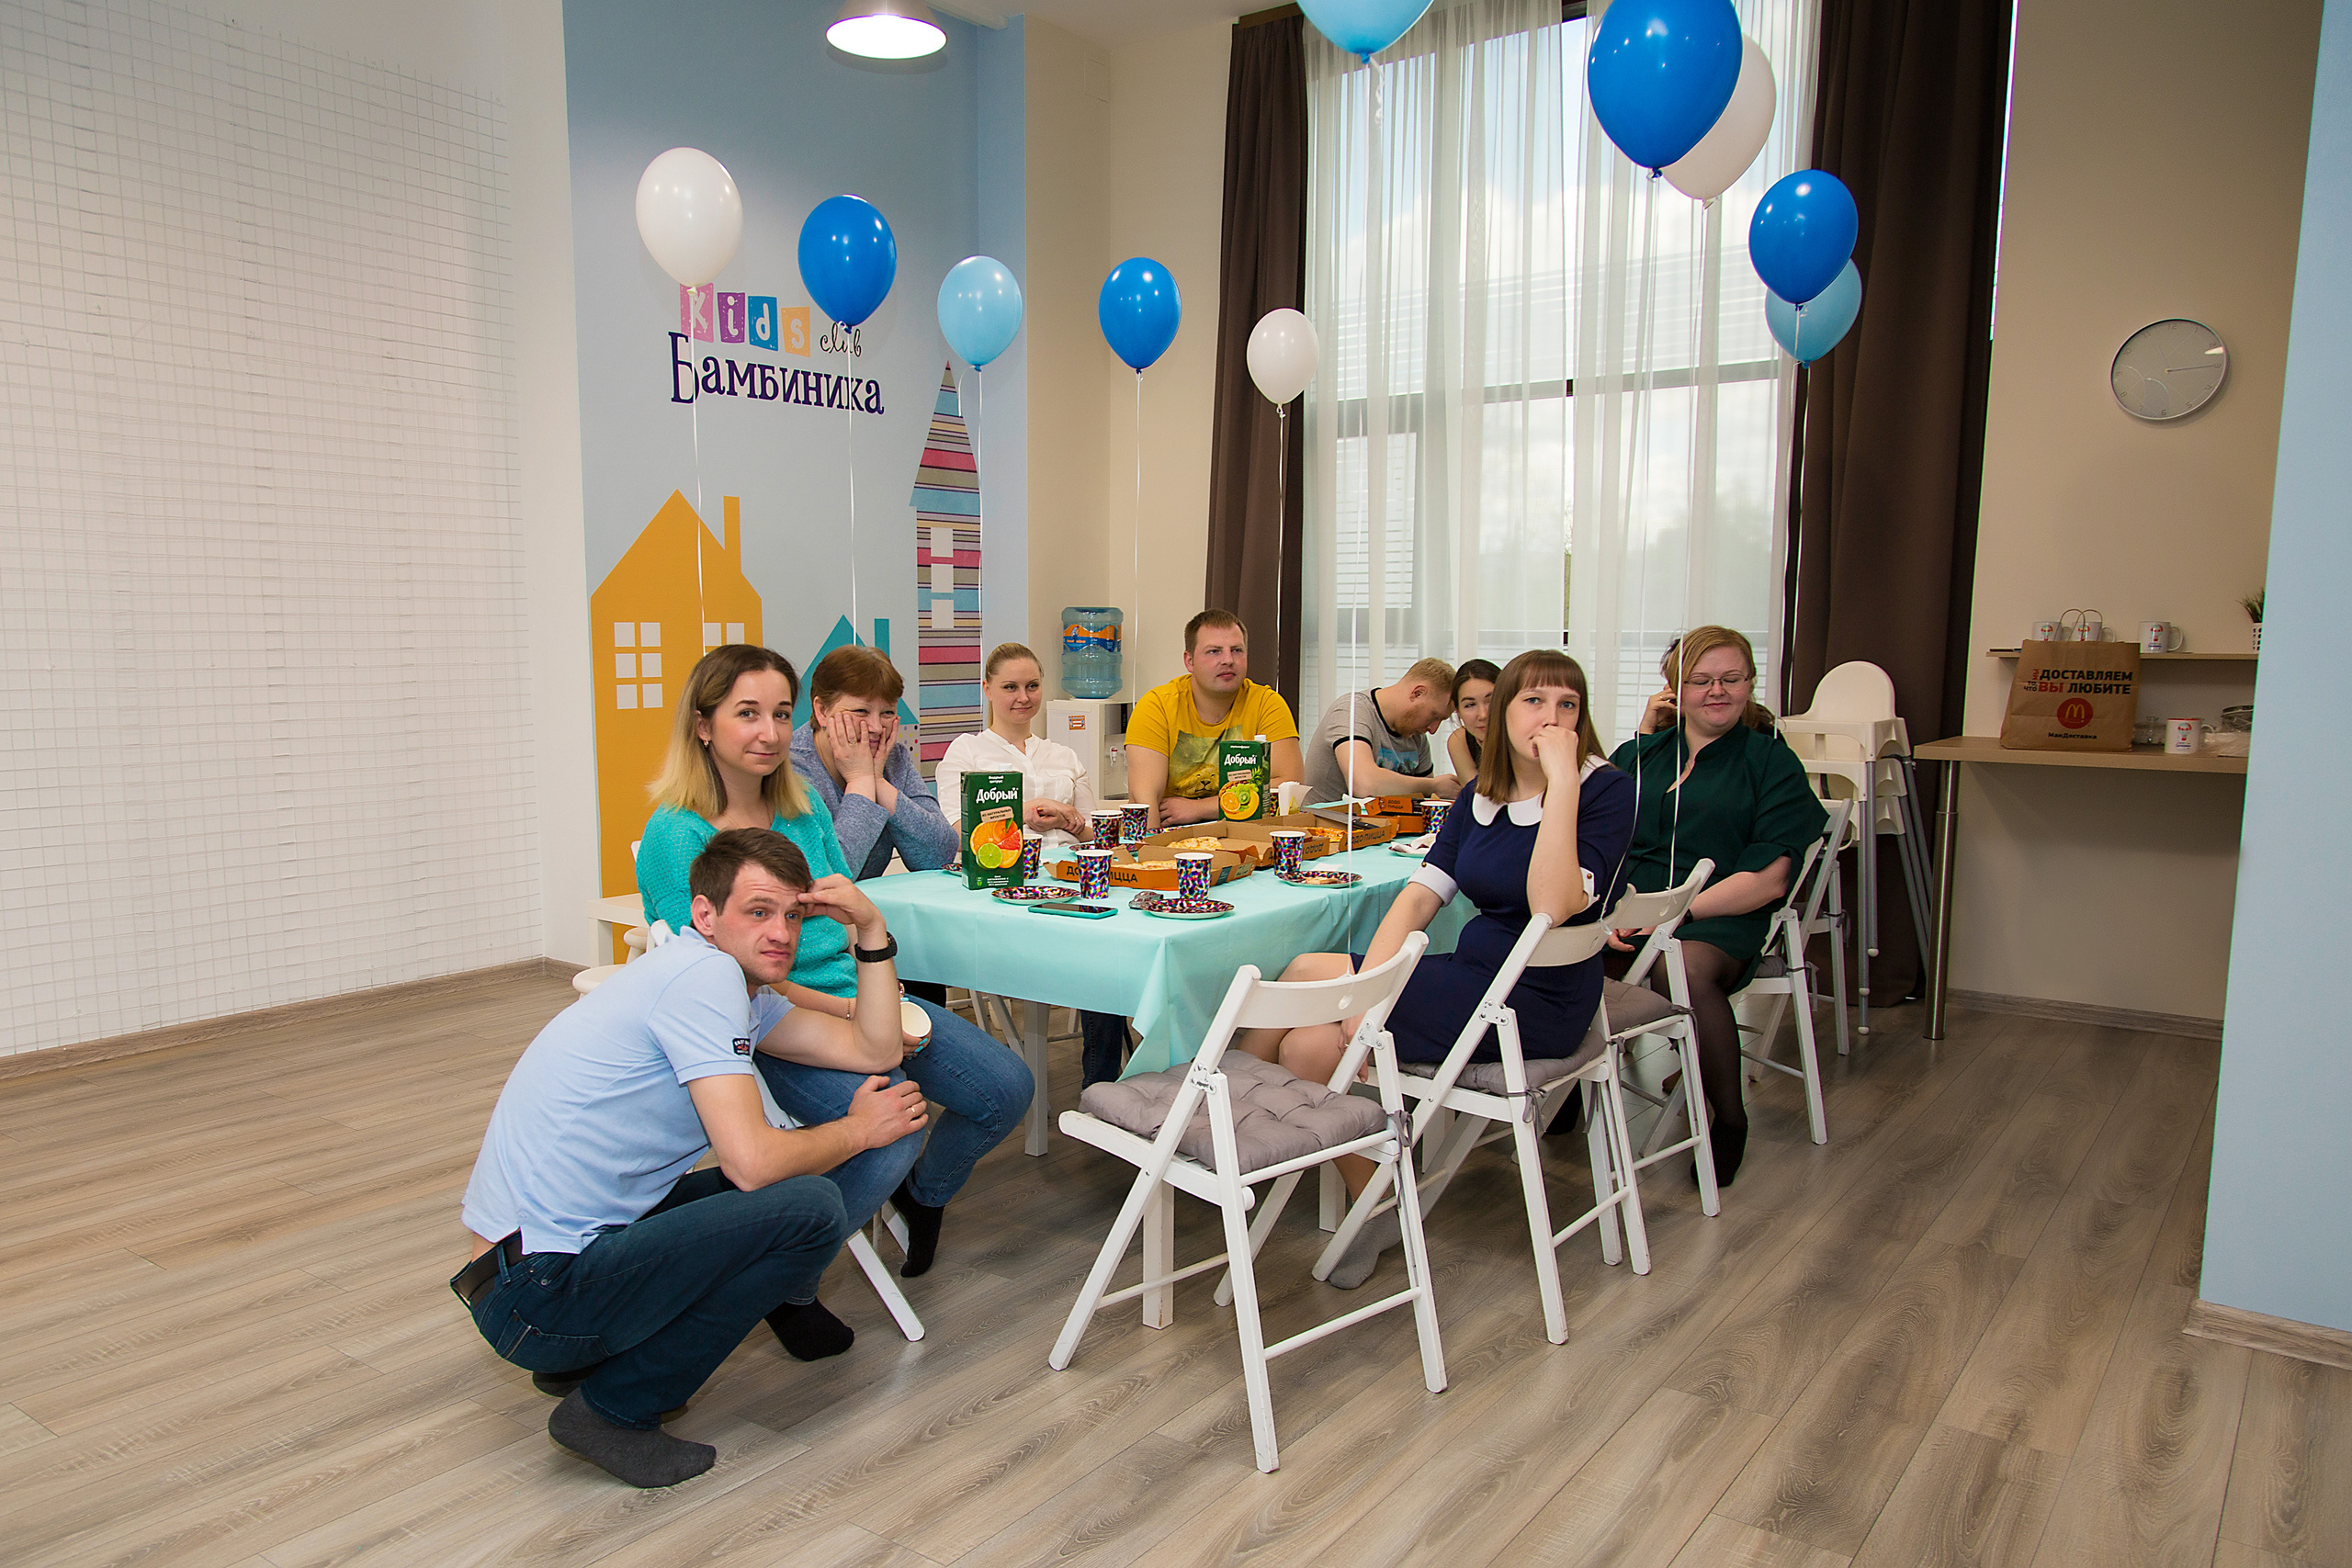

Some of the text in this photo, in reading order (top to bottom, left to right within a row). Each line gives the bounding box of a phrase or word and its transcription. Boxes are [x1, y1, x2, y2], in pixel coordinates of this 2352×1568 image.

[689, 292, 805, 349] Kids
[668, 332, 885, 415] Бамбиника
[2039, 670, 2133, 682] ДОСТАВЛЯЕМ
[2038, 682, 2132, 694] ВЫ ЛЮБИТЕ
[1224, 753, 1257, 766] Добрый
[976, 787, 1018, 804] Добрый
